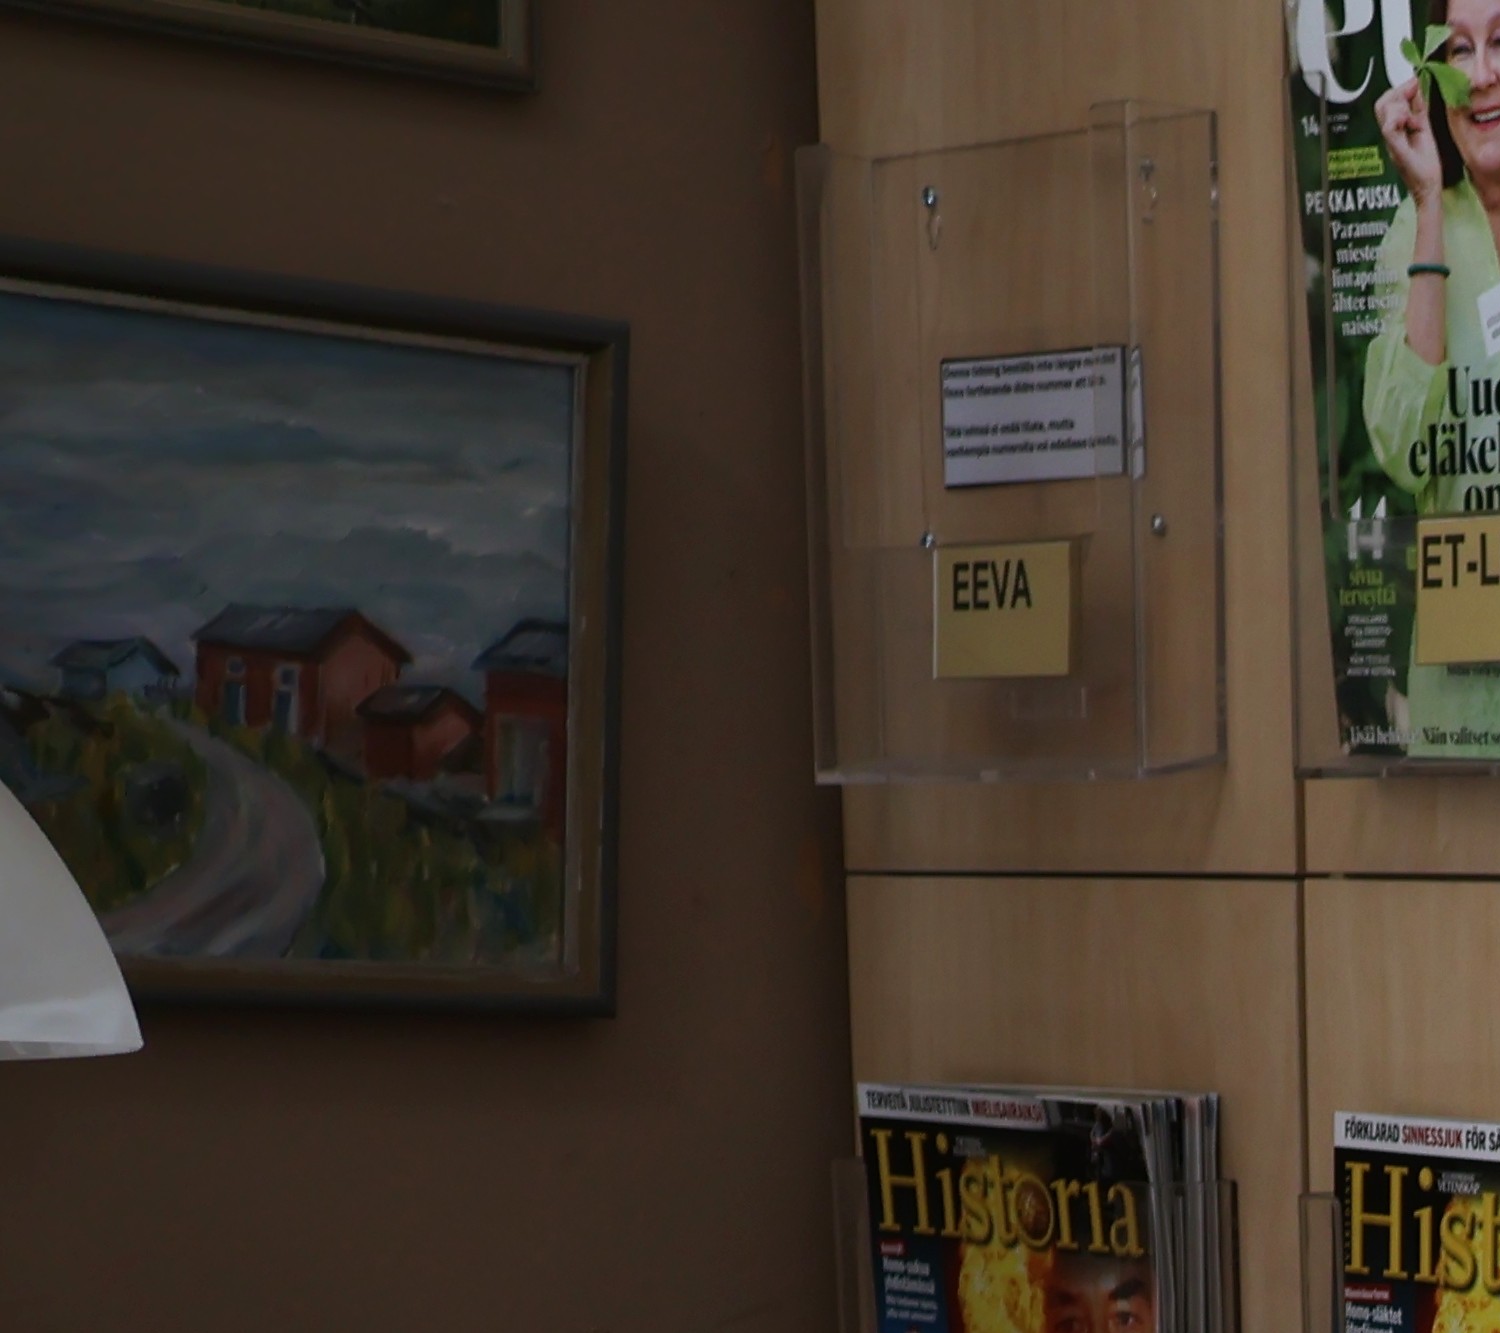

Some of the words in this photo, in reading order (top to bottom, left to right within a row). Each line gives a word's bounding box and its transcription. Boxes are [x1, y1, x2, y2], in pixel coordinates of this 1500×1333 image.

[953, 560, 1032, 610] EEVA
[1344, 1119, 1400, 1142] FÖRKLARAD
[1402, 1124, 1462, 1149] SINNESSJUK
[1466, 1128, 1486, 1151] FÖR
[870, 1127, 1145, 1257] Historia
